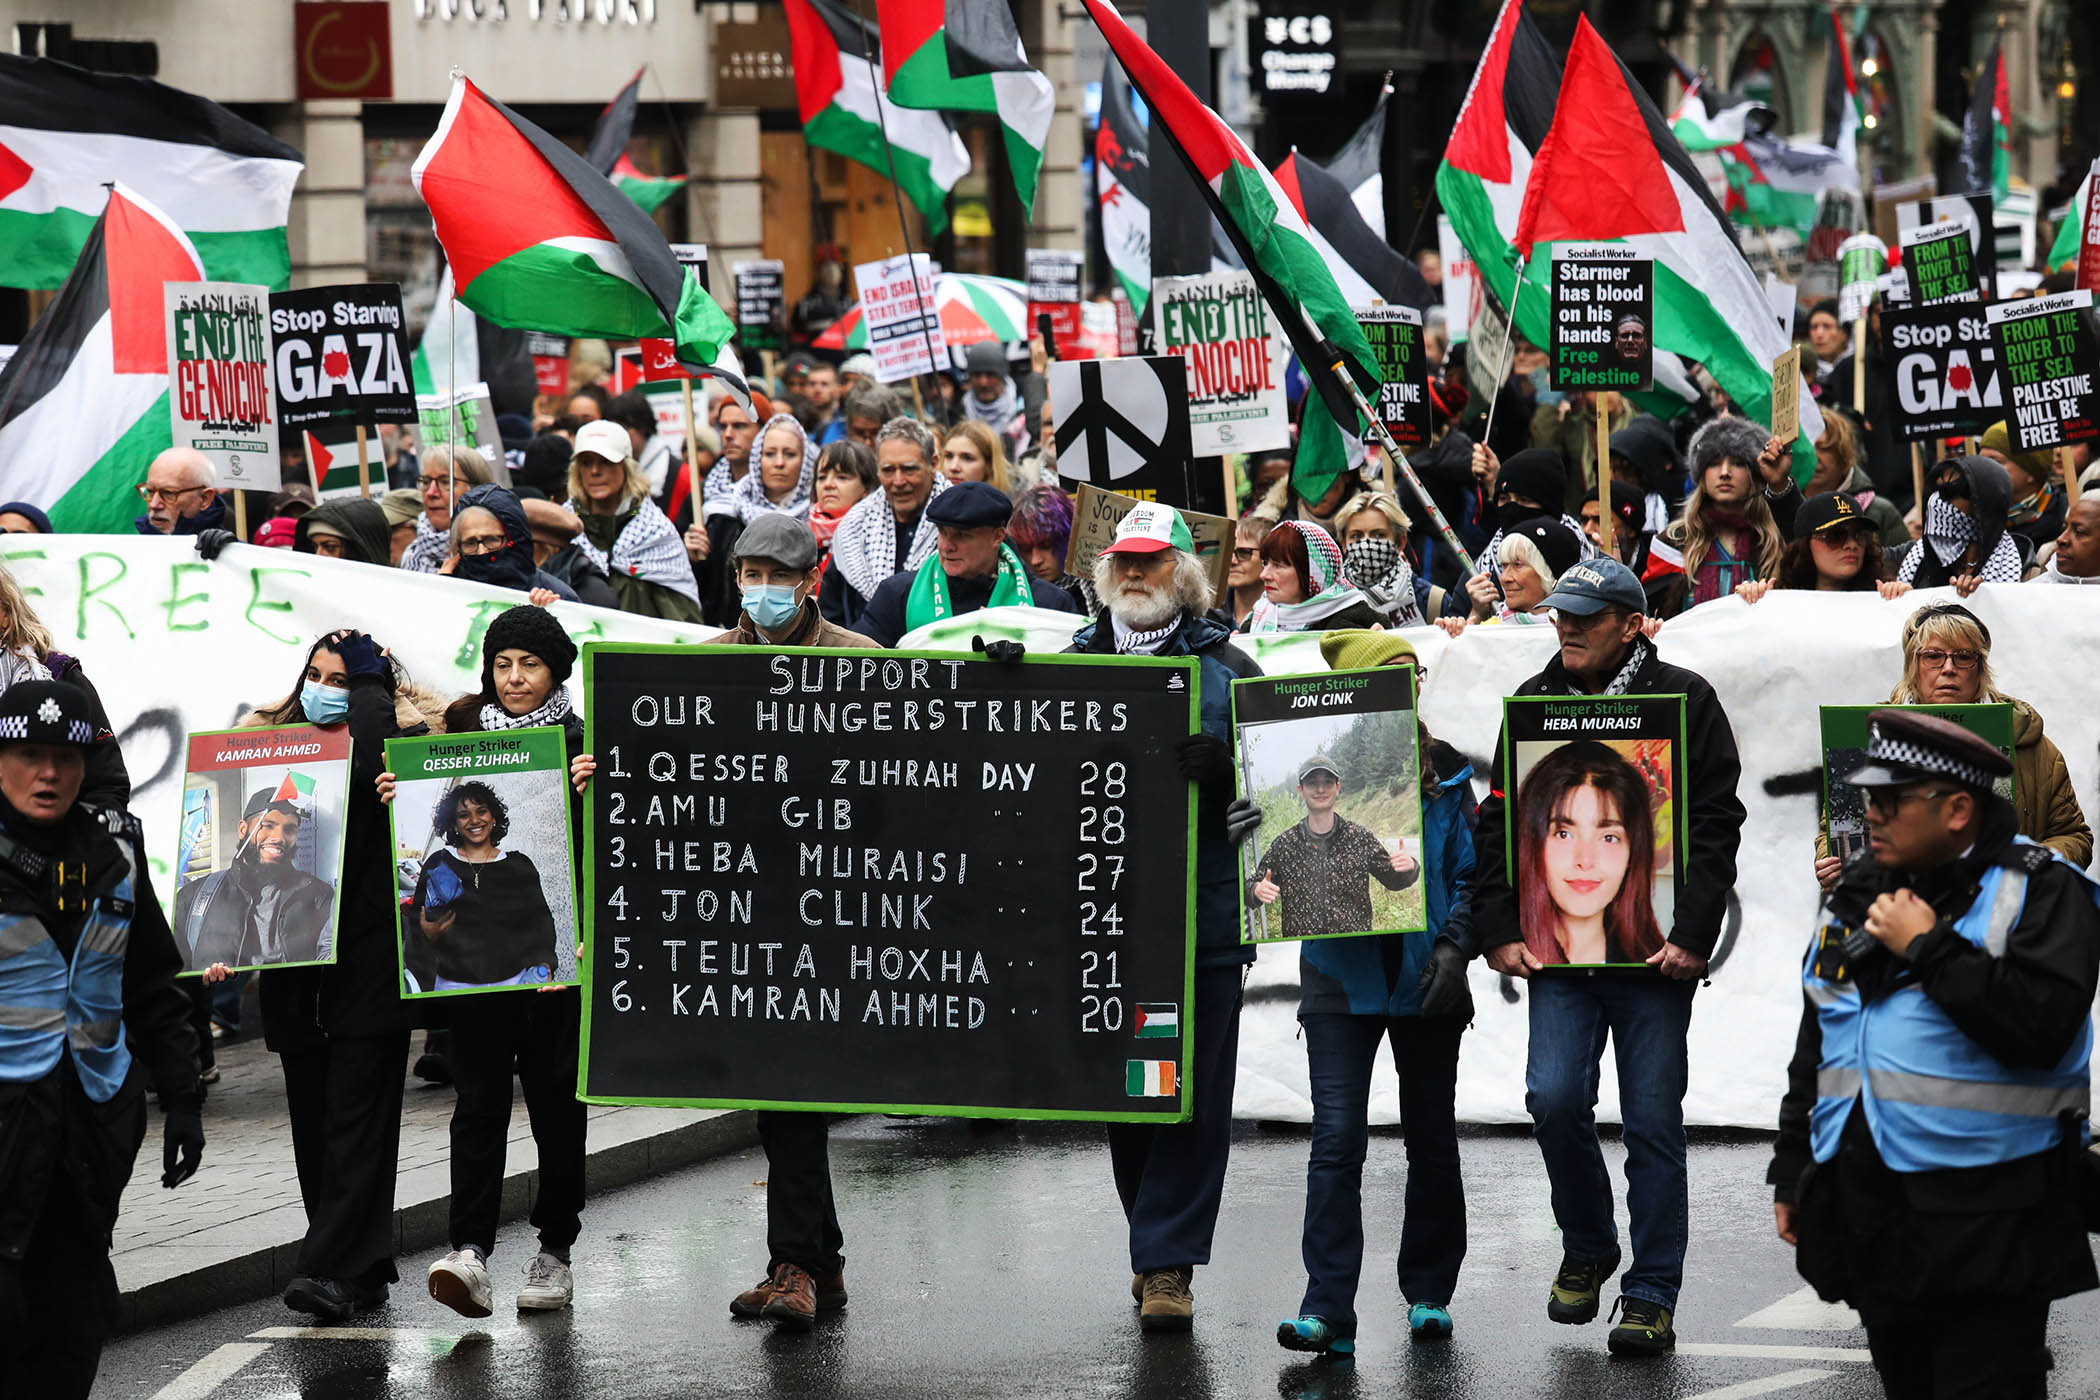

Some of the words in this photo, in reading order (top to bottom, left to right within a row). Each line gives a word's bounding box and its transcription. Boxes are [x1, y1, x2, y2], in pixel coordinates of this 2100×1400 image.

[1261, 51, 1335, 73] Change
[1567, 249, 1606, 259] Socialist
[1607, 249, 1637, 259] Worker
[1913, 240, 1949, 264] FROM
[1559, 262, 1631, 281] Starmer
[1916, 259, 1952, 282] RIVER
[864, 286, 888, 304] END
[890, 275, 931, 298] ISRALI
[1559, 284, 1590, 301] has
[1597, 284, 1643, 301] blood
[1919, 282, 1944, 301] THE
[1946, 274, 1969, 295] SEA
[272, 308, 326, 333] Stop
[333, 301, 399, 329] Starving
[868, 303, 897, 321] STATE
[1559, 308, 1581, 322] on
[1587, 305, 1612, 322] his
[2003, 303, 2044, 319] Socialist
[2044, 298, 2075, 310] Worker
[1163, 300, 1226, 346] END
[1391, 325, 1414, 344] THE
[1559, 326, 1611, 343] hands
[2001, 317, 2049, 344] FROM
[2052, 311, 2079, 334] THE
[175, 310, 236, 360] END
[238, 312, 267, 365] THE
[1892, 322, 1951, 348] Stop
[1392, 345, 1409, 361] TO
[1559, 346, 1599, 364] Free
[2005, 339, 2053, 365] RIVER
[2056, 334, 2076, 354] TO
[276, 333, 409, 402] GAZA
[1167, 338, 1276, 399] NOCIDE
[1380, 365, 1405, 382] SEA
[1559, 367, 1640, 384] Palestine
[2008, 362, 2041, 385] THE
[2044, 356, 2074, 379] SEA
[178, 359, 271, 424] GENOCIDE
[1381, 383, 1421, 403] STINE
[2012, 374, 2093, 407] PALESTINE
[1386, 402, 1405, 421] BE
[2015, 402, 2057, 427] WILL
[2059, 397, 2080, 420] BE
[2020, 422, 2061, 449] FREE
[1833, 495, 1853, 514] LA
[769, 656, 966, 695] SUPPORT
[1275, 681, 1322, 695] Hunger
[1326, 677, 1369, 691] Striker
[1290, 695, 1319, 709] JON
[1321, 692, 1354, 706] CINK
[1545, 703, 1591, 717] Hunger
[1595, 702, 1640, 714] Striker
[631, 695, 715, 727] OUR
[756, 699, 1128, 734] HUNGERSTRIKERS
[1543, 718, 1578, 730] HEBA
[1581, 717, 1642, 730] MURAISI
[226, 735, 271, 749] Hunger
[273, 732, 313, 744] Striker
[429, 743, 476, 756] Hunger
[479, 739, 522, 752] Striker
[215, 748, 271, 763] KAMRAN
[273, 743, 322, 759] AHMED
[423, 756, 472, 772] QESSER
[474, 752, 530, 767] ZUHRAH
[609, 745, 632, 778] 1.
[648, 751, 789, 782] QESSER
[830, 759, 958, 788] ZUHRAH
[982, 761, 1036, 792] DAY
[1080, 760, 1127, 798] 28
[609, 792, 637, 825] 2.
[645, 794, 725, 826] AMU
[781, 796, 852, 831] GIB
[1079, 805, 1126, 845] 28
[609, 836, 637, 868] 3.
[655, 838, 759, 874] HEBA
[800, 842, 967, 884] MURAISI
[1077, 852, 1125, 891] 27
[607, 885, 641, 921] 4.
[661, 889, 753, 924] JON
[799, 888, 933, 930] CLINK
[1079, 901, 1124, 936] 24
[614, 936, 644, 970] 5.
[662, 940, 816, 979] TEUTA
[850, 944, 990, 984] HOXHA
[1080, 950, 1122, 989] 21
[611, 980, 646, 1012] 6.
[672, 983, 841, 1022] KAMRAN
[861, 989, 986, 1029] AHMED
[1080, 994, 1123, 1033] 20
